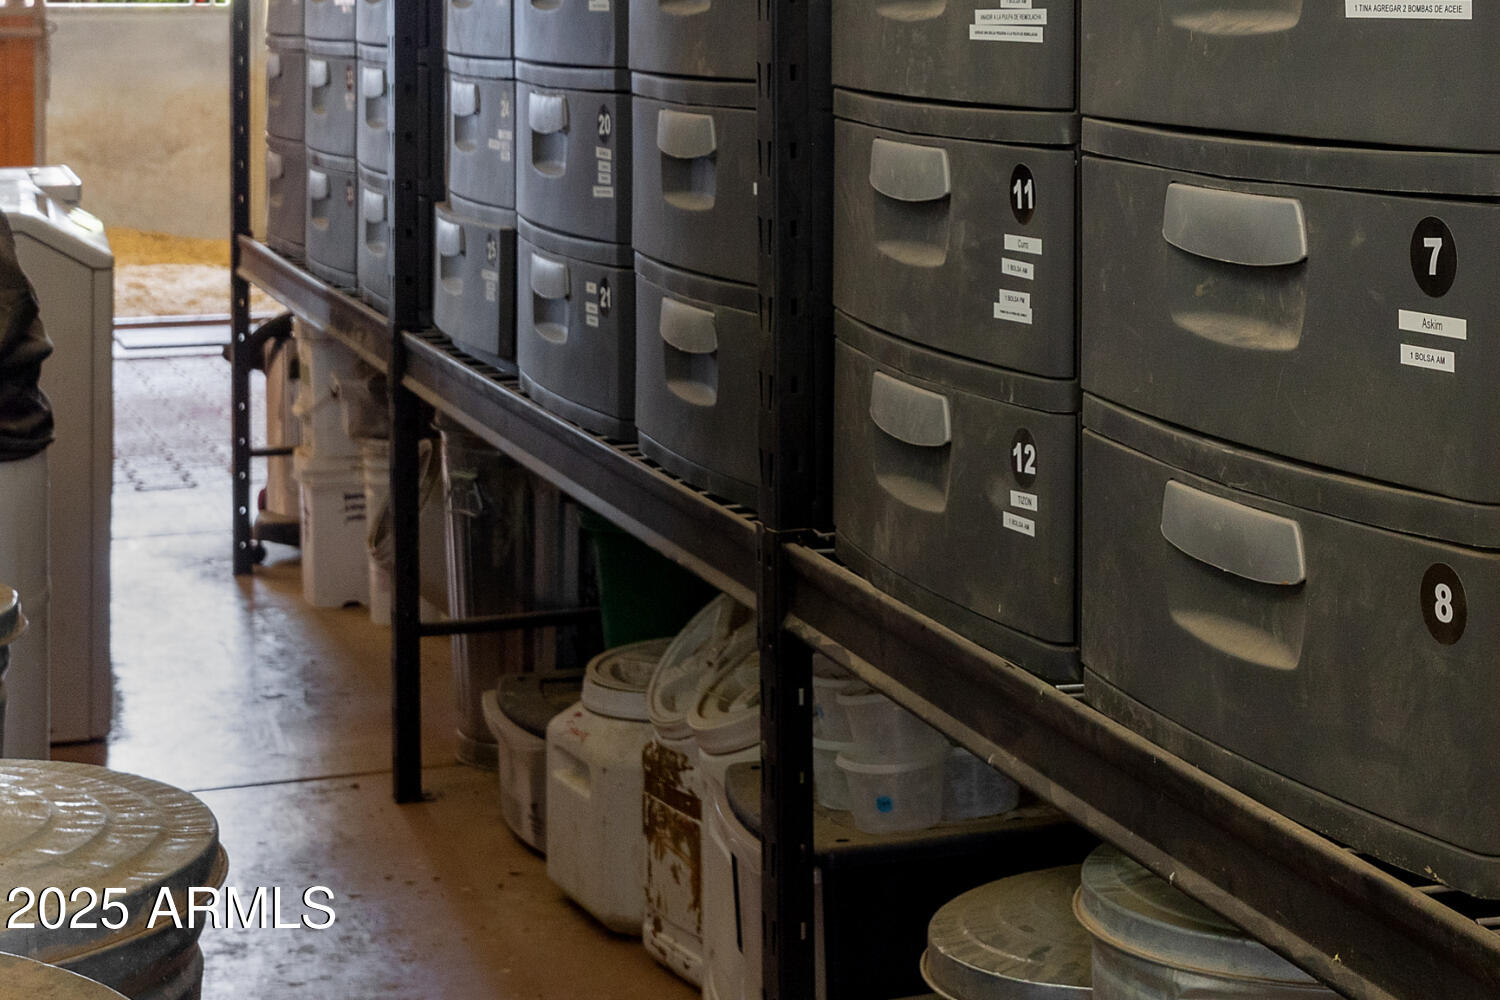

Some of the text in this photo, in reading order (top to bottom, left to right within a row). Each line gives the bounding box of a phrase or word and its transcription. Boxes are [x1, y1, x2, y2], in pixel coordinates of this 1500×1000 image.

[1359, 4, 1372, 12] TINA
[1373, 4, 1401, 13] AGREGAR
[1408, 4, 1433, 13] BOMBAS
[1434, 4, 1443, 13] DE
[598, 113, 612, 136] 20
[1013, 178, 1034, 210] 11
[1423, 237, 1443, 276] 7
[600, 285, 612, 309] 21
[1422, 317, 1443, 331] Askim
[1415, 351, 1435, 363] BOLSA
[1436, 355, 1446, 365] AM
[1012, 442, 1036, 475] 12
[1434, 583, 1454, 624] 8
